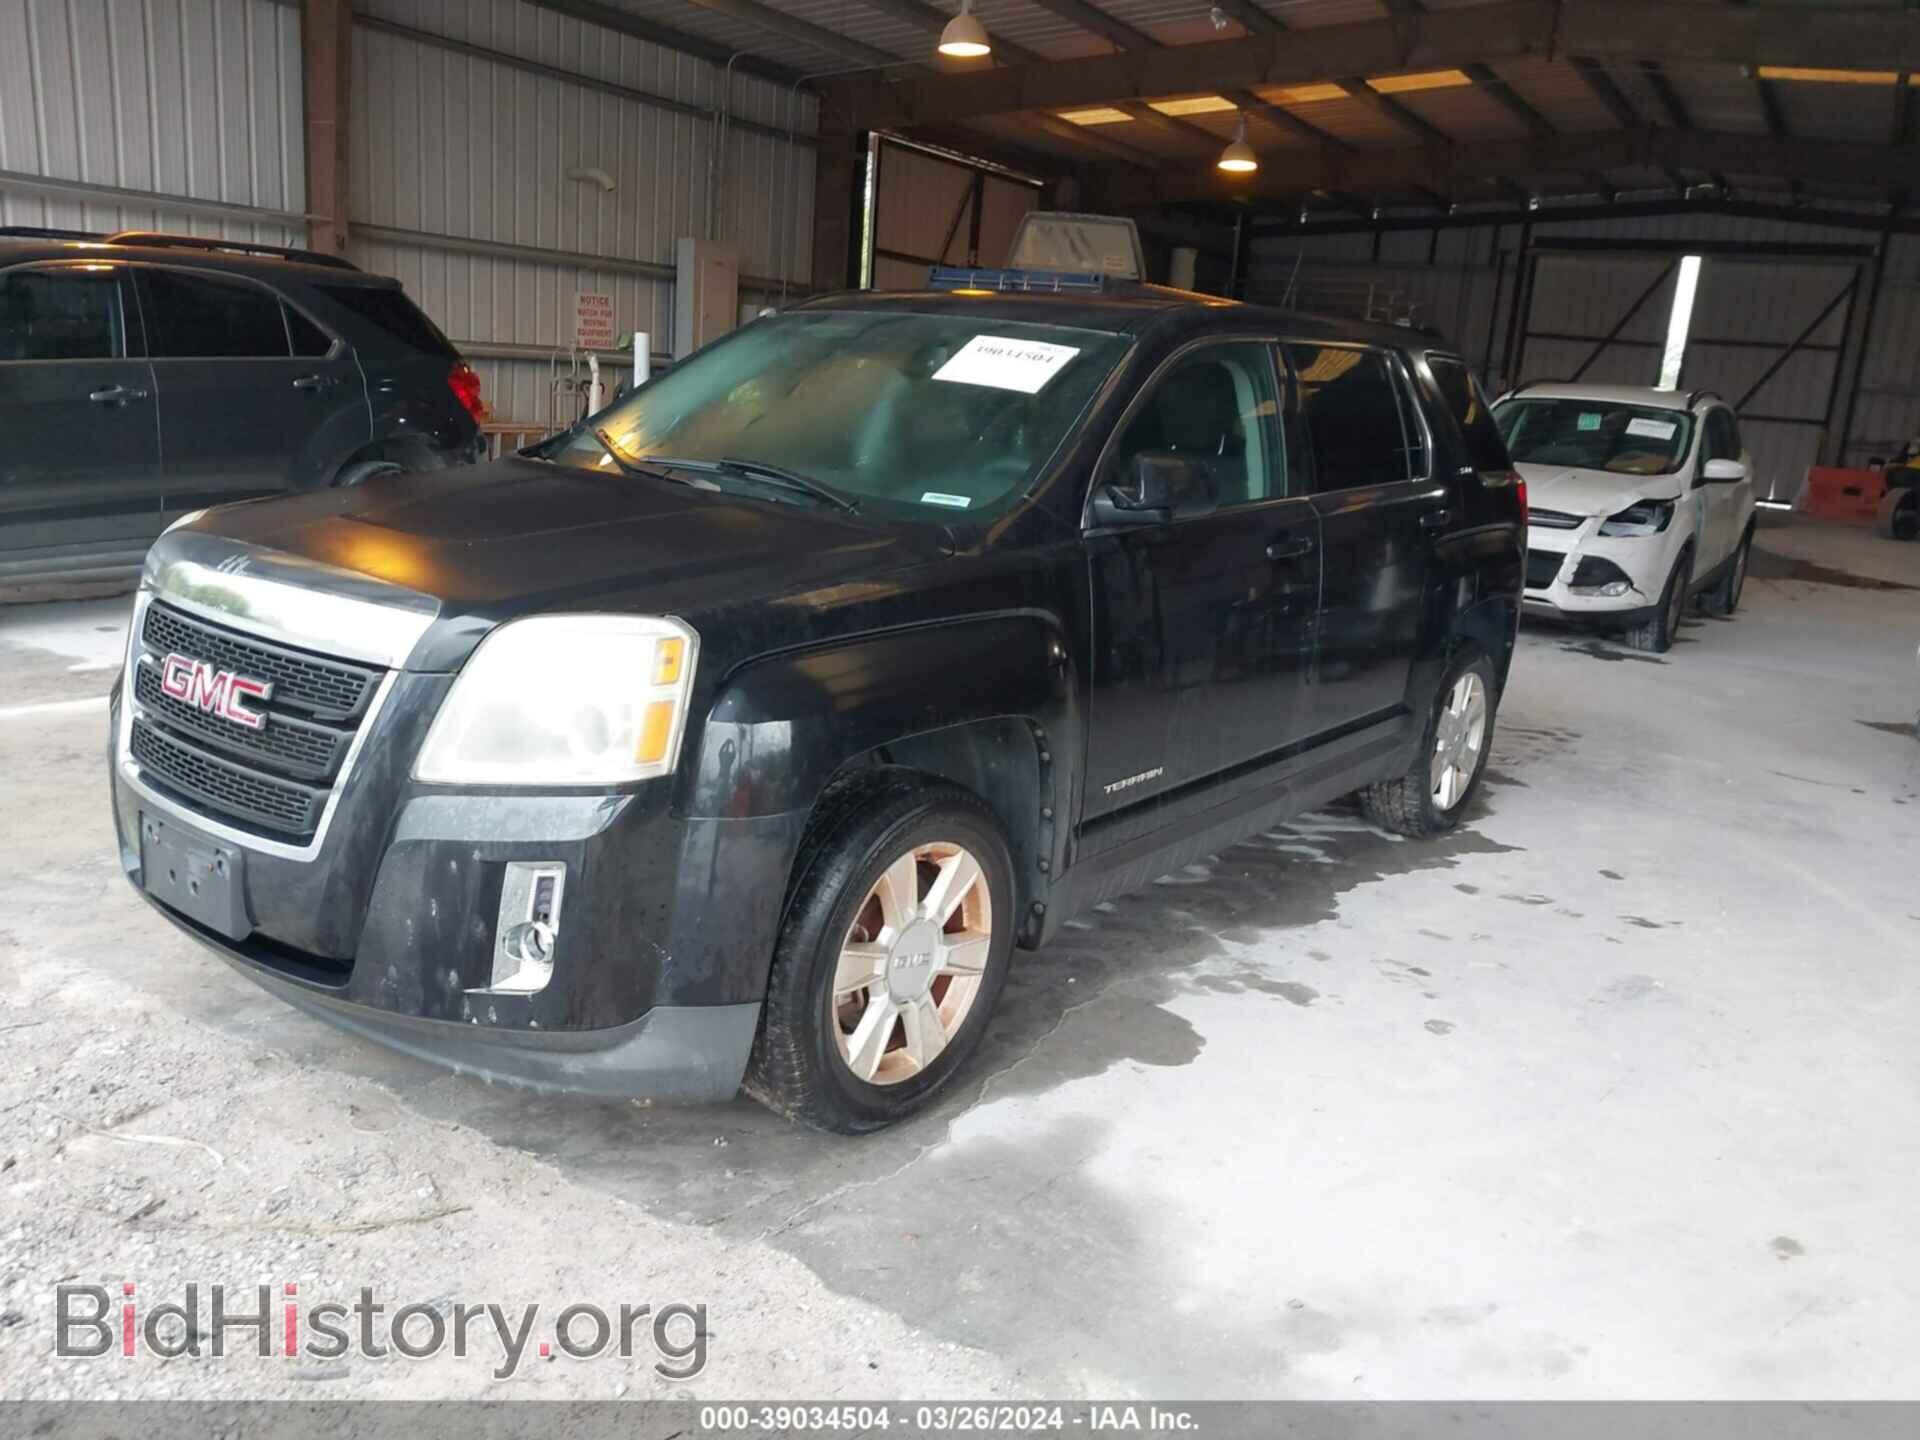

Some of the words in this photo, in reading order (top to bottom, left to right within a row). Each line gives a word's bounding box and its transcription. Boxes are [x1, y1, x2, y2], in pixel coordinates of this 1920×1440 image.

[580, 295, 609, 305] NOTICE
[577, 328, 613, 337] EQUIPMENT
[162, 652, 274, 730] GMC
[1103, 766, 1164, 795] TERRAIN
